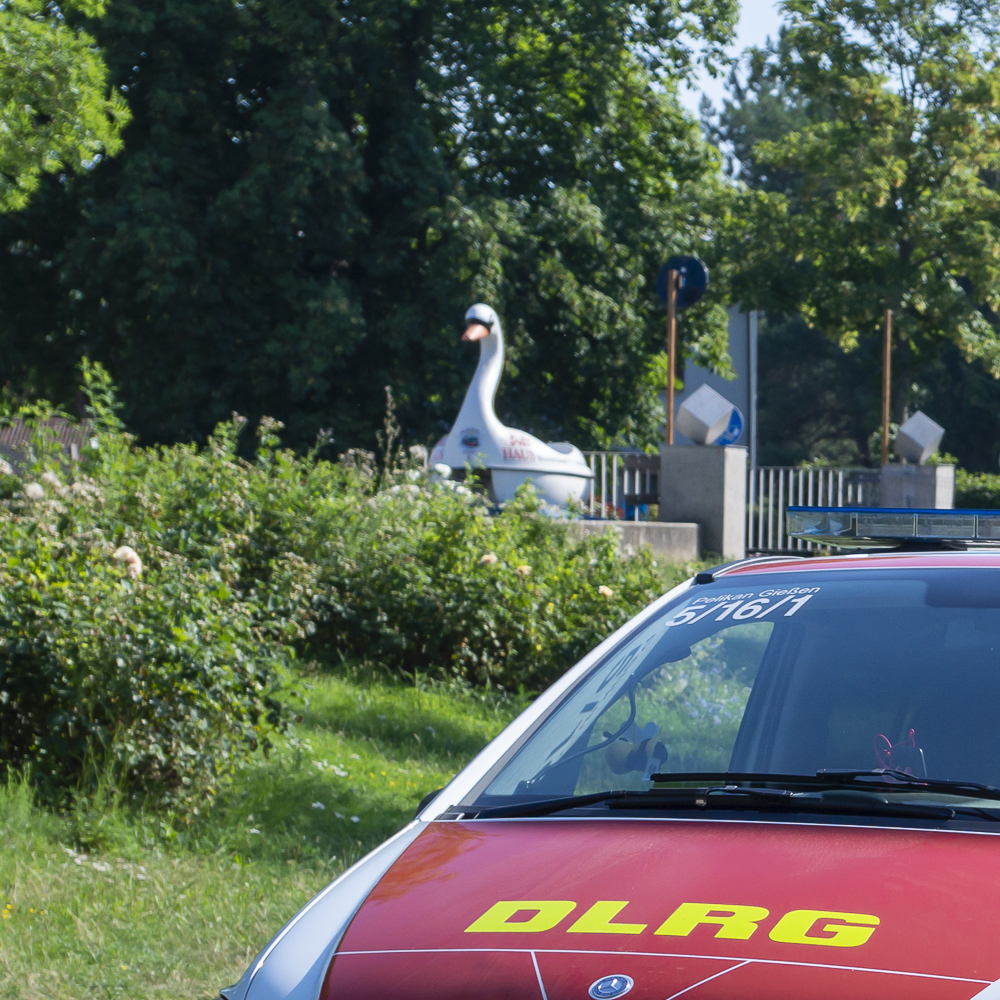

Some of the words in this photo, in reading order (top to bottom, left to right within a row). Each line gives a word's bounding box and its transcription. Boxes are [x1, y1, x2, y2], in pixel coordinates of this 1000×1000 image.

[665, 595, 814, 628] 5/16/1
[692, 592, 754, 606] Pelikan
[758, 586, 821, 599] Gießen
[463, 900, 881, 948] DLRG
